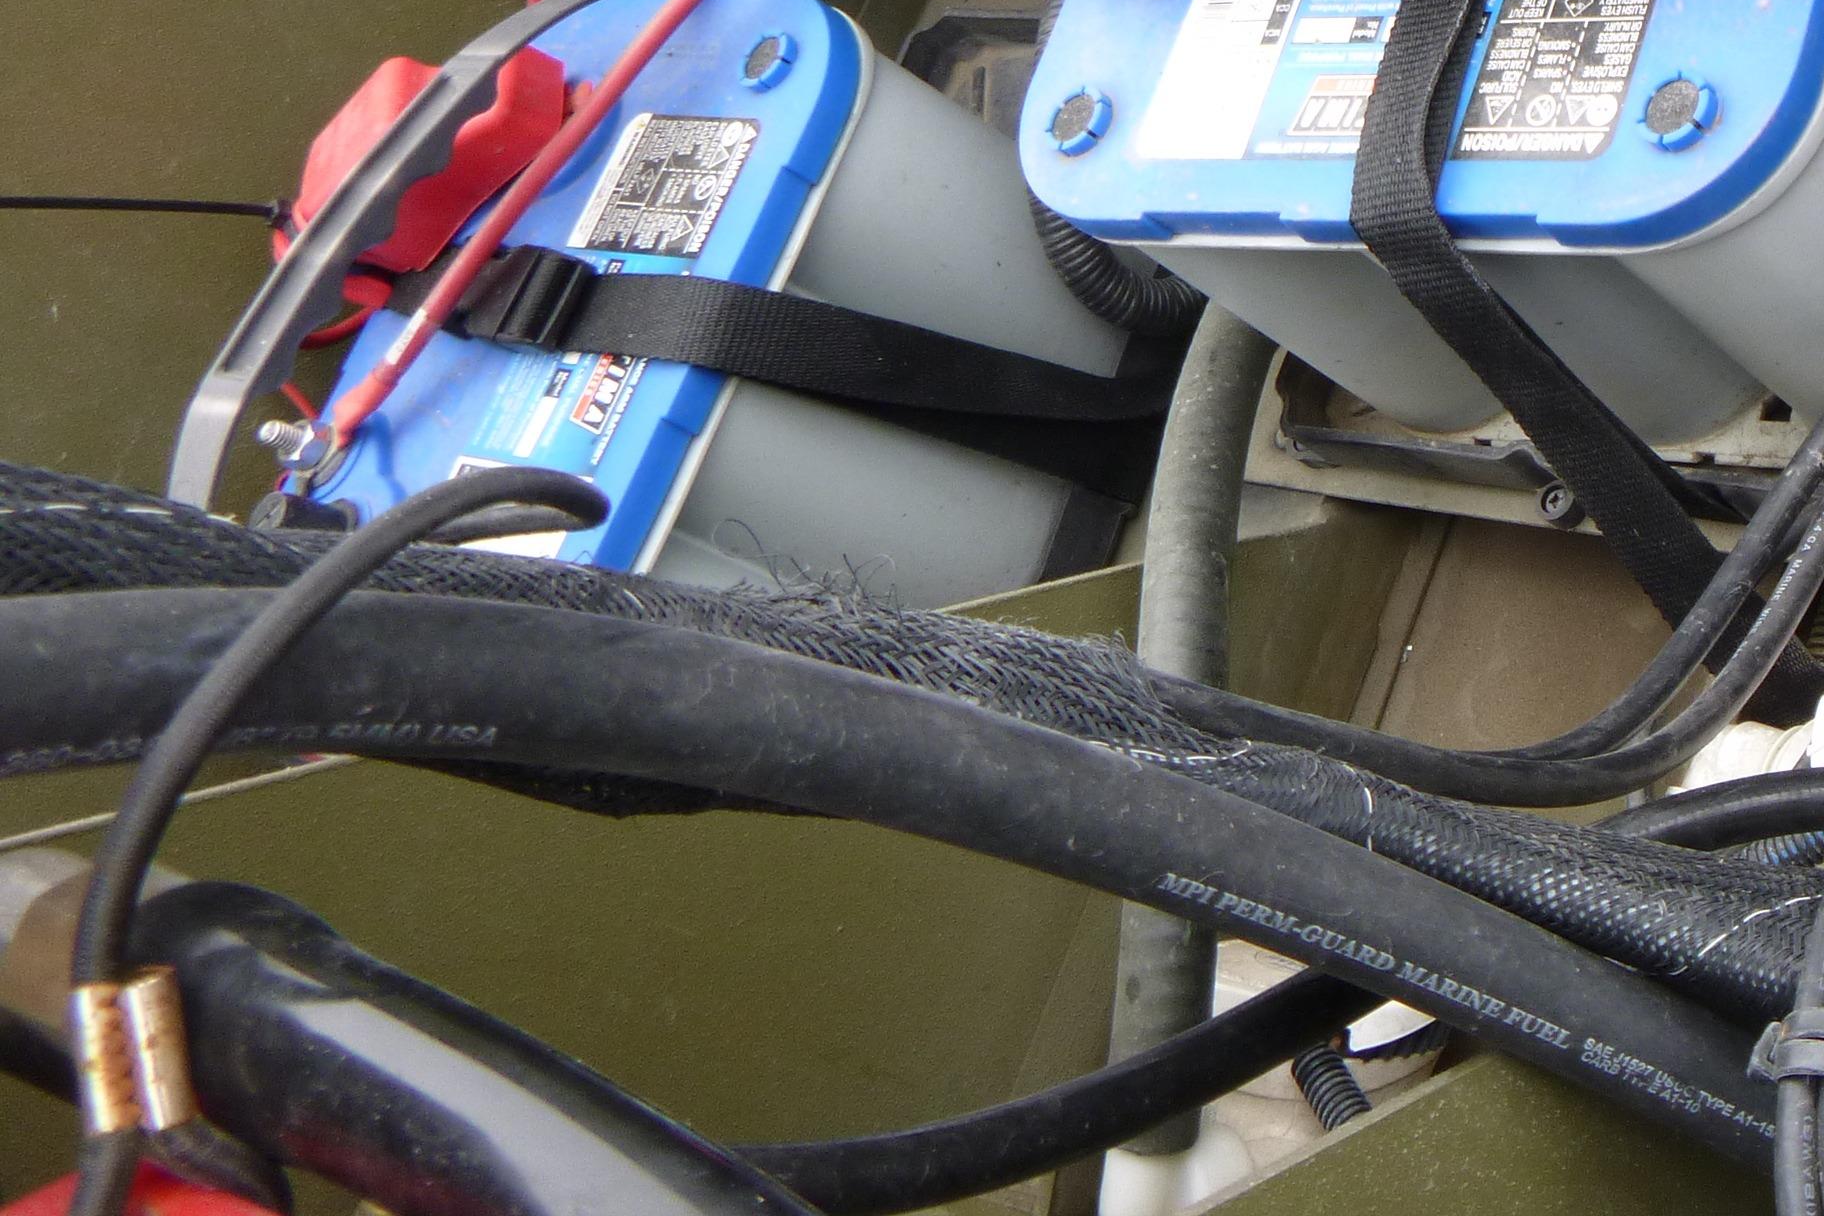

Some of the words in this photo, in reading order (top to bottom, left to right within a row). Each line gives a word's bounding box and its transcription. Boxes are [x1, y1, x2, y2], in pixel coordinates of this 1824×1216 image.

[1507, 8, 1522, 17] OUT
[1523, 8, 1543, 17] KEEP
[1599, 5, 1620, 15] EYES
[1621, 4, 1647, 14] FLUSH
[1630, 21, 1641, 30] OR
[1597, 32, 1639, 41] BLINDNESS
[1494, 38, 1520, 48] SEVERE
[1520, 38, 1532, 47] OR
[1536, 40, 1570, 49] SMOKING
[1594, 42, 1615, 53] CAUSE
[1616, 42, 1635, 52] CAN
[1489, 49, 1529, 58] BLINDNESS
[1536, 54, 1566, 64] FLAMES
[1602, 54, 1632, 64] GASES
[1485, 60, 1507, 69] CAUSE
[1508, 60, 1525, 69] CAN
[1501, 71, 1522, 80] ACID
[1532, 68, 1561, 78] SPARKS
[1581, 65, 1628, 76] EXPLOSIVE
[1478, 82, 1518, 93] SULFURIC
[1549, 81, 1563, 92] NO
[1594, 80, 1623, 92] SHIELD
[1460, 132, 1582, 150] DANGER/POISON
[687, 143, 749, 252] DANGER/POISON
[1801, 535, 1816, 552] GA
[1771, 559, 1802, 600] MARINE
[1158, 872, 1218, 904] MPI
[1215, 892, 1396, 971] PERM-GUARD
[1396, 961, 1505, 1018] MARINE
[1503, 1007, 1571, 1049] FUEL
[1583, 1038, 1615, 1062] SAE
[1614, 1052, 1654, 1076] J1527
[1698, 1090, 1735, 1117] TYPE
[1581, 1052, 1620, 1076] CARB
[1661, 1090, 1700, 1114] A1-10
